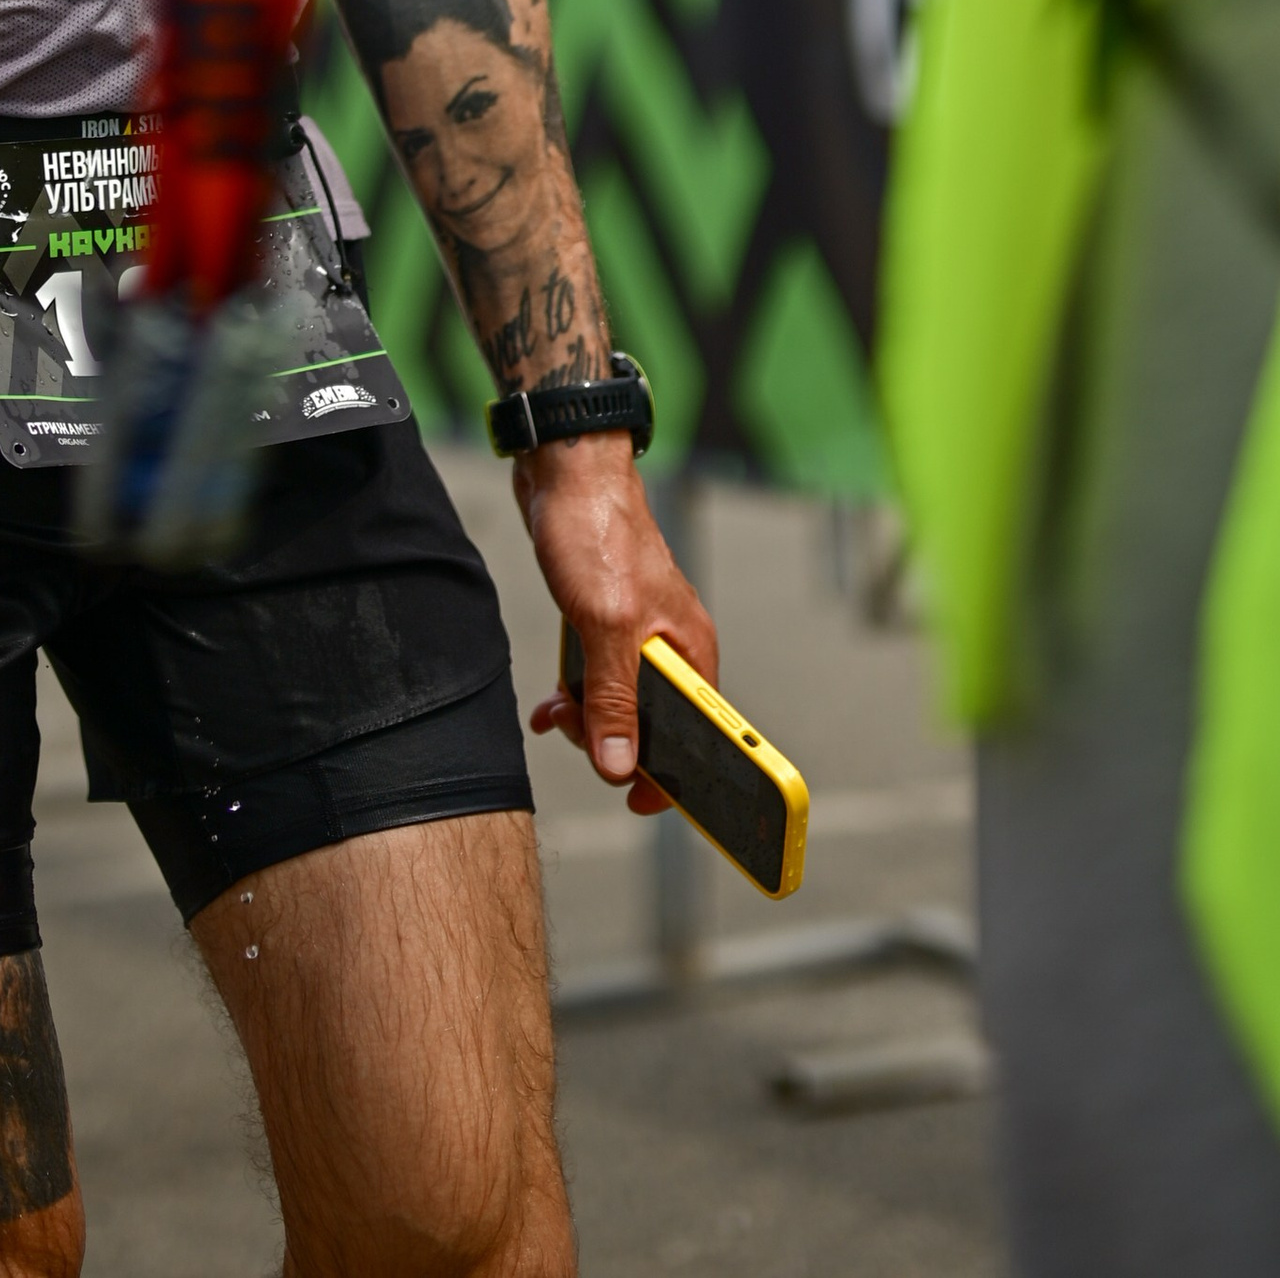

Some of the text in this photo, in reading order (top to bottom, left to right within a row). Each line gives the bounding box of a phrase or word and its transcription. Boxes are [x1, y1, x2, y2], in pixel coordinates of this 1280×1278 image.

[81, 114, 163, 138] IRON STA
[43, 145, 163, 181] НЕВИННОМЫ
[45, 175, 160, 214] УЛЬТРАМА
[49, 225, 151, 258] KAVKA
[35, 265, 154, 376] 1
[541, 268, 574, 341] to
[27, 421, 105, 435] СТРИЖАМЕНТ
[57, 438, 90, 446] ORGANIC
